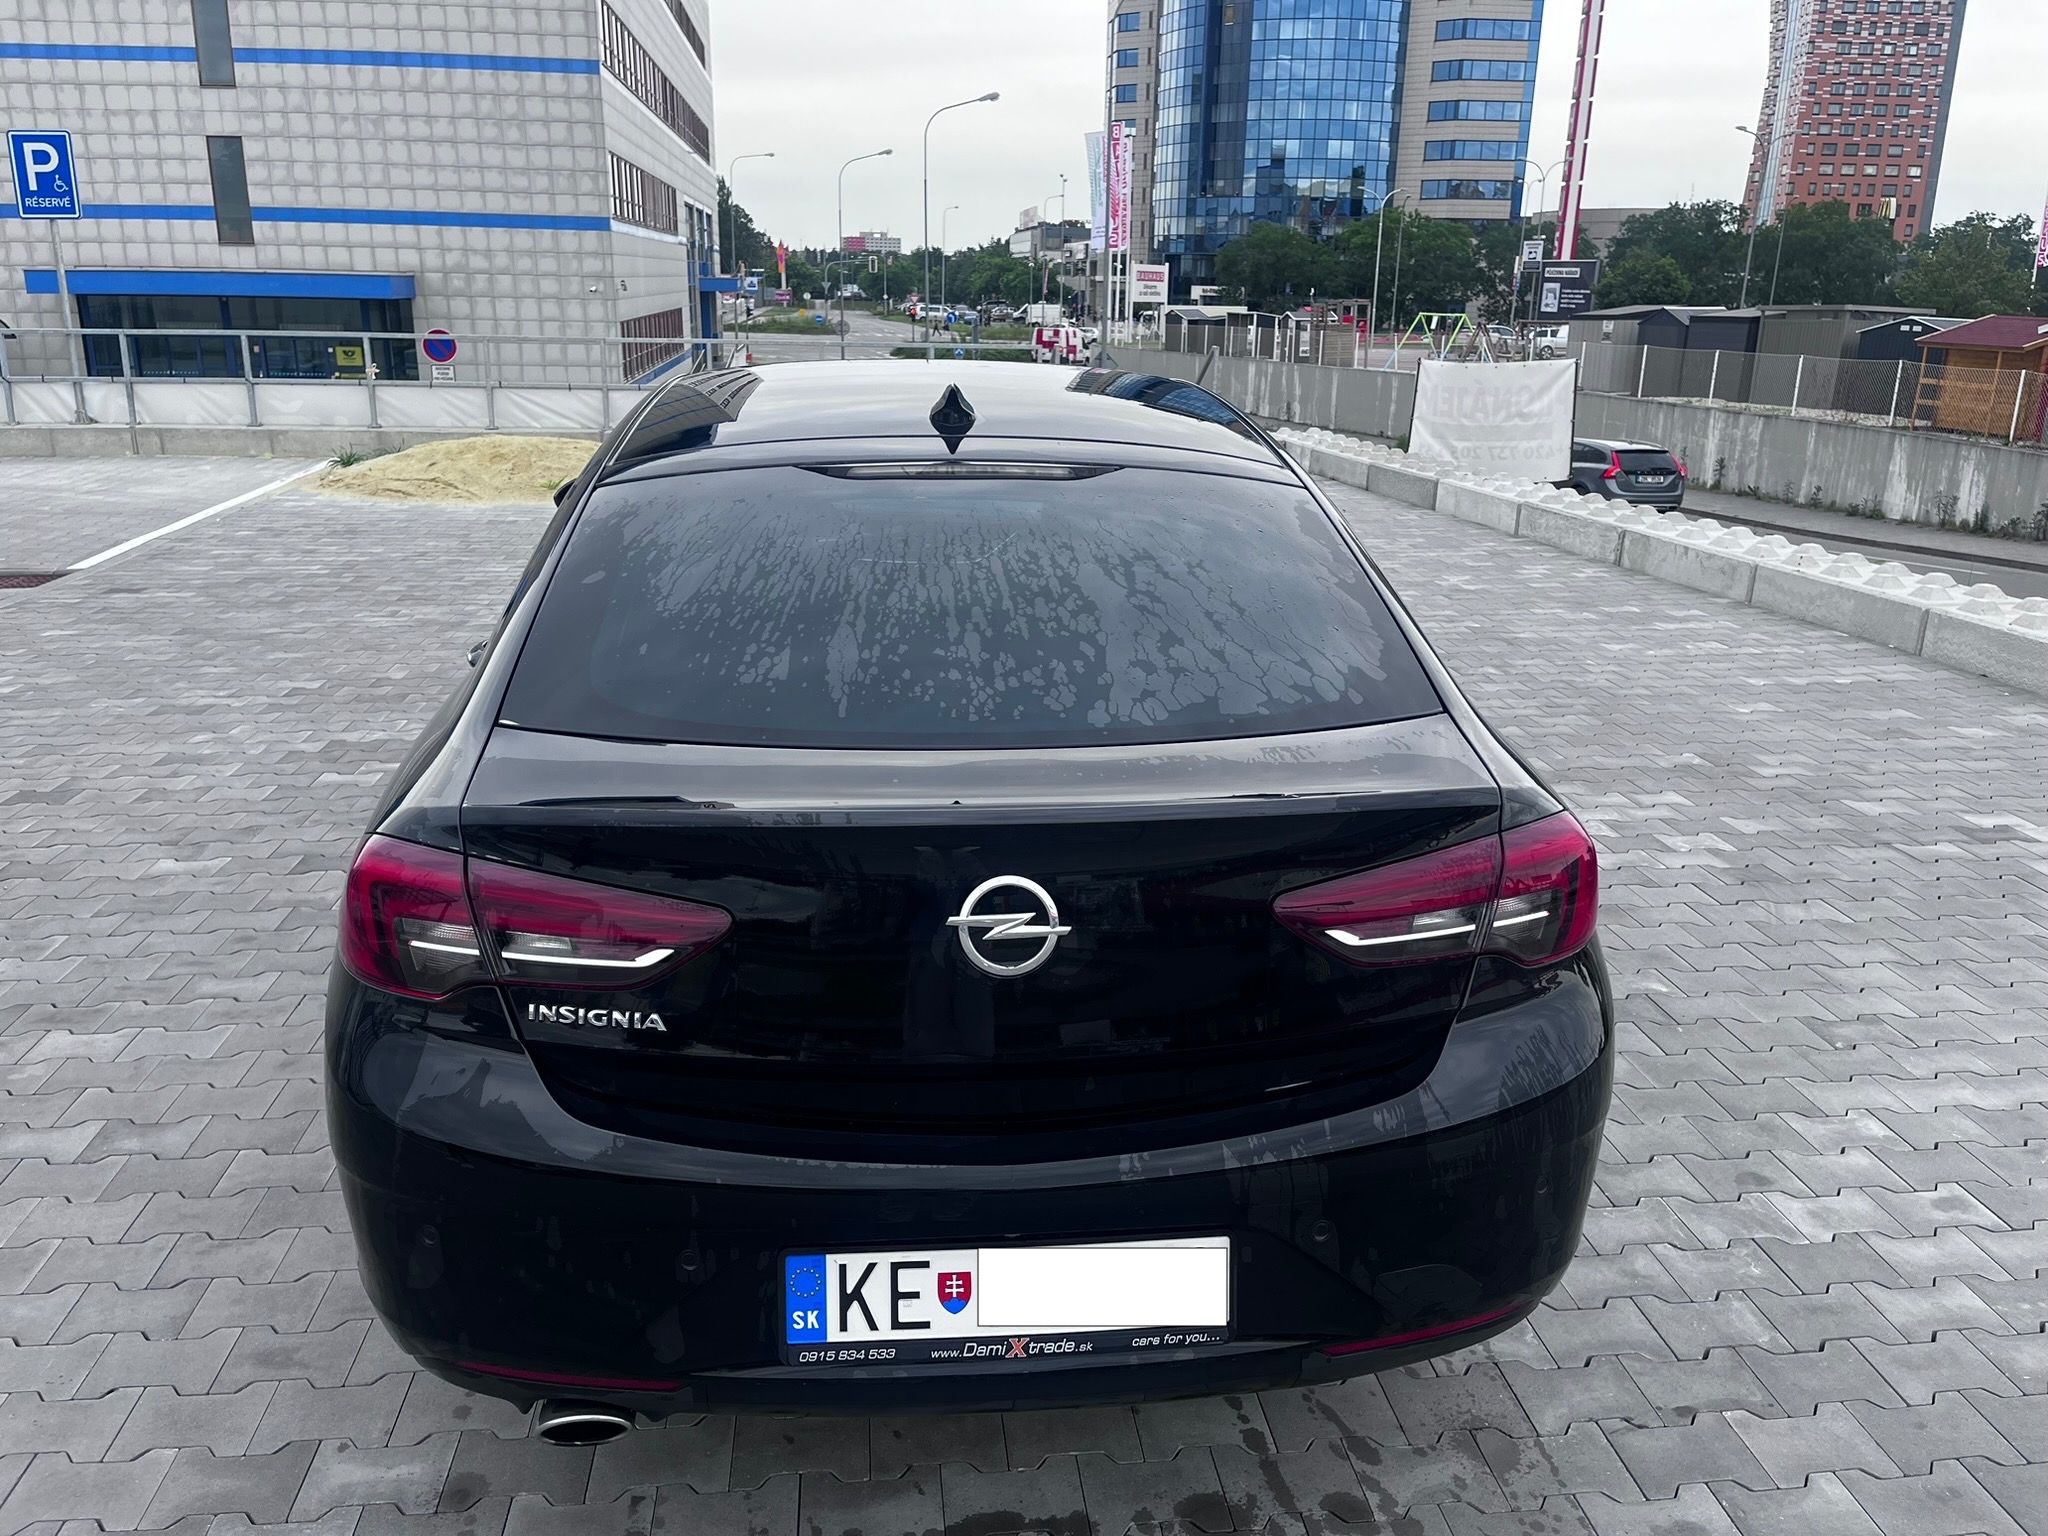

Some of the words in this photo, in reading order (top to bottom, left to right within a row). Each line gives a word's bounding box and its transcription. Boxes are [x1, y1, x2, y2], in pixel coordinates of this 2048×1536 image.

[23, 142, 59, 191] P
[25, 196, 71, 207] RÉSERVÉ
[528, 1003, 667, 1031] INSIGNIA
[838, 1260, 931, 1333] KE
[792, 1310, 819, 1330] SK
[931, 1337, 1094, 1359] www.DamiXtrade.sk
[1132, 1336, 1161, 1347] cars
[1163, 1333, 1183, 1344] for
[1186, 1333, 1220, 1345] you...
[799, 1351, 836, 1362] 0915
[838, 1350, 865, 1361] 834
[868, 1348, 896, 1360] 533
